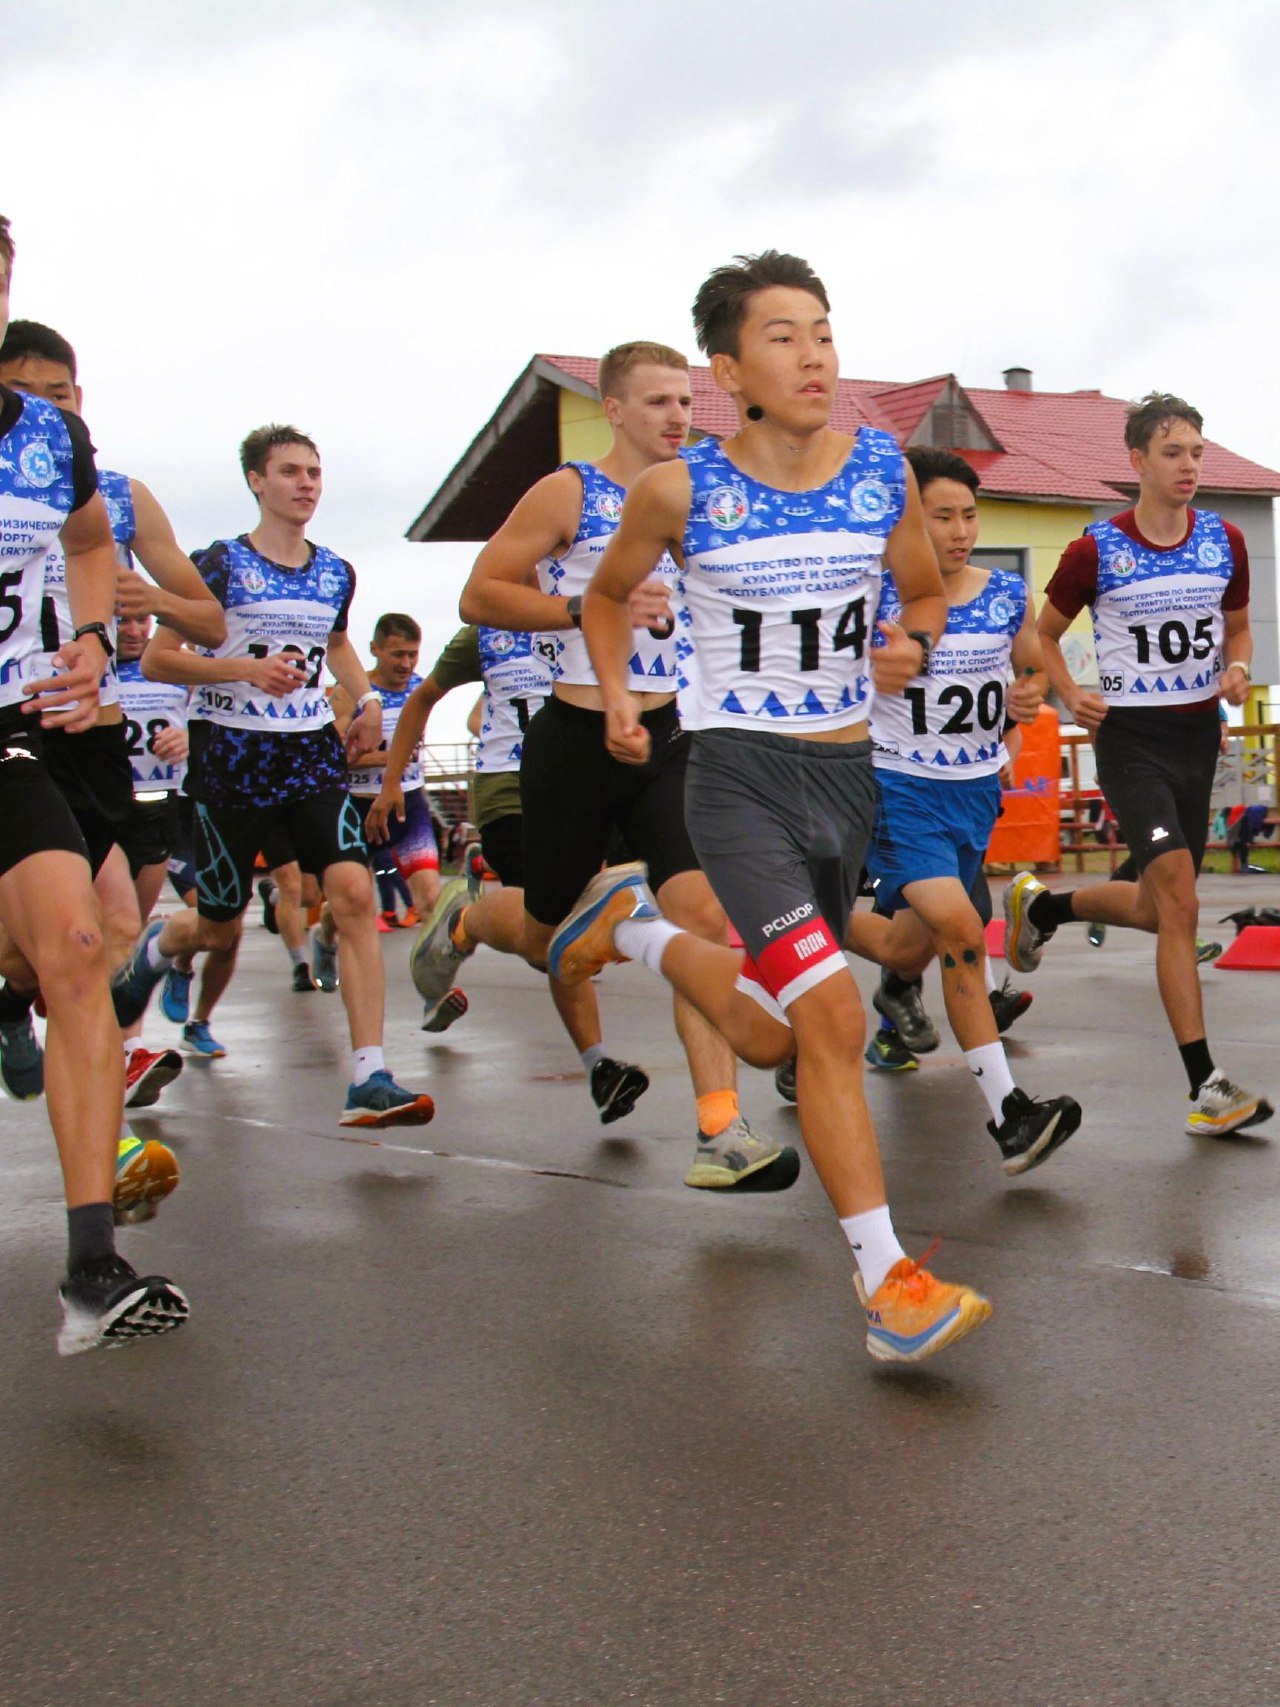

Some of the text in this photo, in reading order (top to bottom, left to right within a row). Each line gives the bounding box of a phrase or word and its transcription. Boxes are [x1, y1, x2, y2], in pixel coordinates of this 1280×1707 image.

[0, 532, 35, 543] ОРТУ
[699, 557, 801, 573] МИНИСТЕРСТВО
[804, 556, 824, 566] ПО
[742, 569, 805, 585] КУЛЬТУРЕ
[809, 569, 819, 579] И
[718, 585, 802, 598] РЕСПУБЛИКИ
[1108, 590, 1170, 603] МИНИСТЕРСТВО
[1134, 598, 1173, 608] КУЛЬТУРЕ
[1183, 594, 1212, 602] СПОРТУ
[732, 596, 868, 672] 114
[1128, 616, 1215, 664] 105
[205, 690, 234, 711] 102
[904, 681, 1004, 735] 120
[762, 902, 814, 938] РСШОР
[793, 929, 828, 961] IRON
